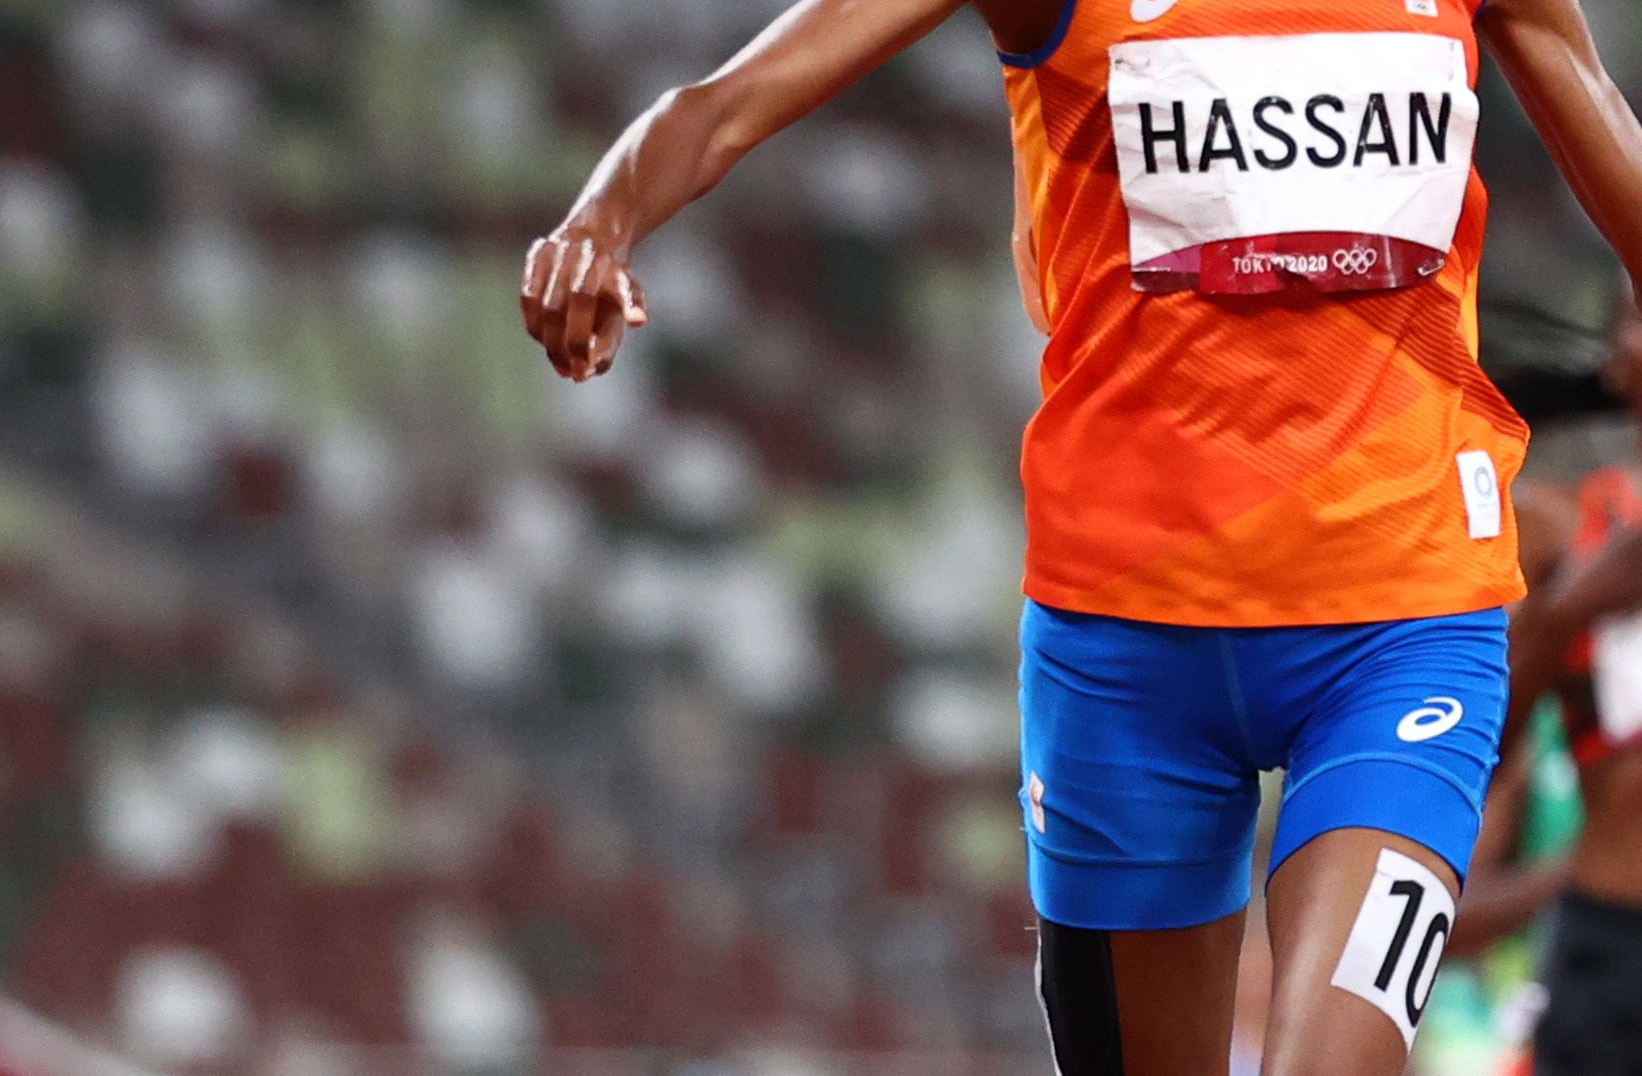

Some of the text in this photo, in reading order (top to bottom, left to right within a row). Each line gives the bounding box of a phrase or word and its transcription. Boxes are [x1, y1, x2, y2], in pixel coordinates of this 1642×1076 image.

[1139, 91, 1451, 174] HASSAN
[1287, 255, 1328, 273] 2020
[1373, 880, 1449, 1028] 10
